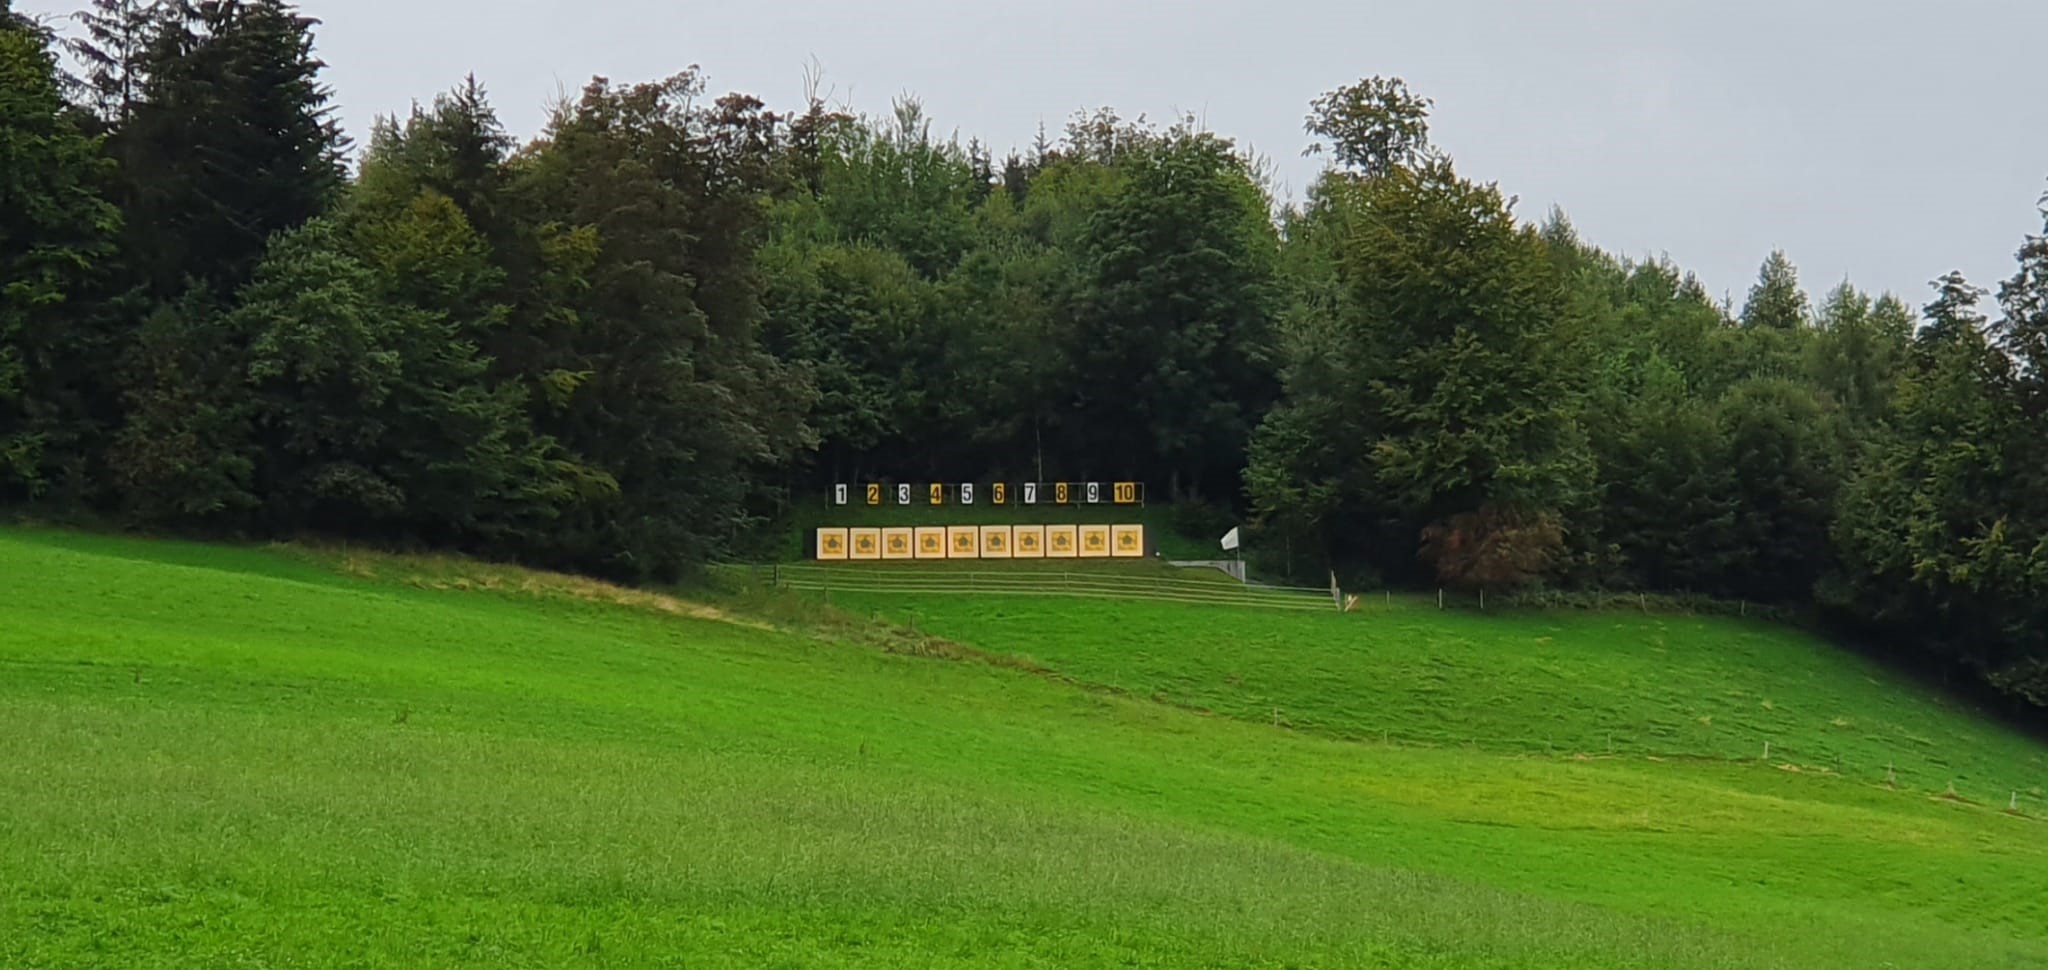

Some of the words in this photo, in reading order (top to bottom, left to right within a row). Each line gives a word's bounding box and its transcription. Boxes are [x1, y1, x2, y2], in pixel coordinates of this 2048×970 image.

[838, 486, 845, 502] 1
[868, 486, 877, 502] 2
[900, 486, 909, 502] 3
[931, 486, 940, 502] 4
[962, 486, 972, 502] 5
[994, 485, 1003, 501] 6
[1025, 485, 1035, 501] 7
[1057, 485, 1066, 501] 8
[1088, 485, 1098, 501] 9
[1116, 485, 1133, 501] 10
